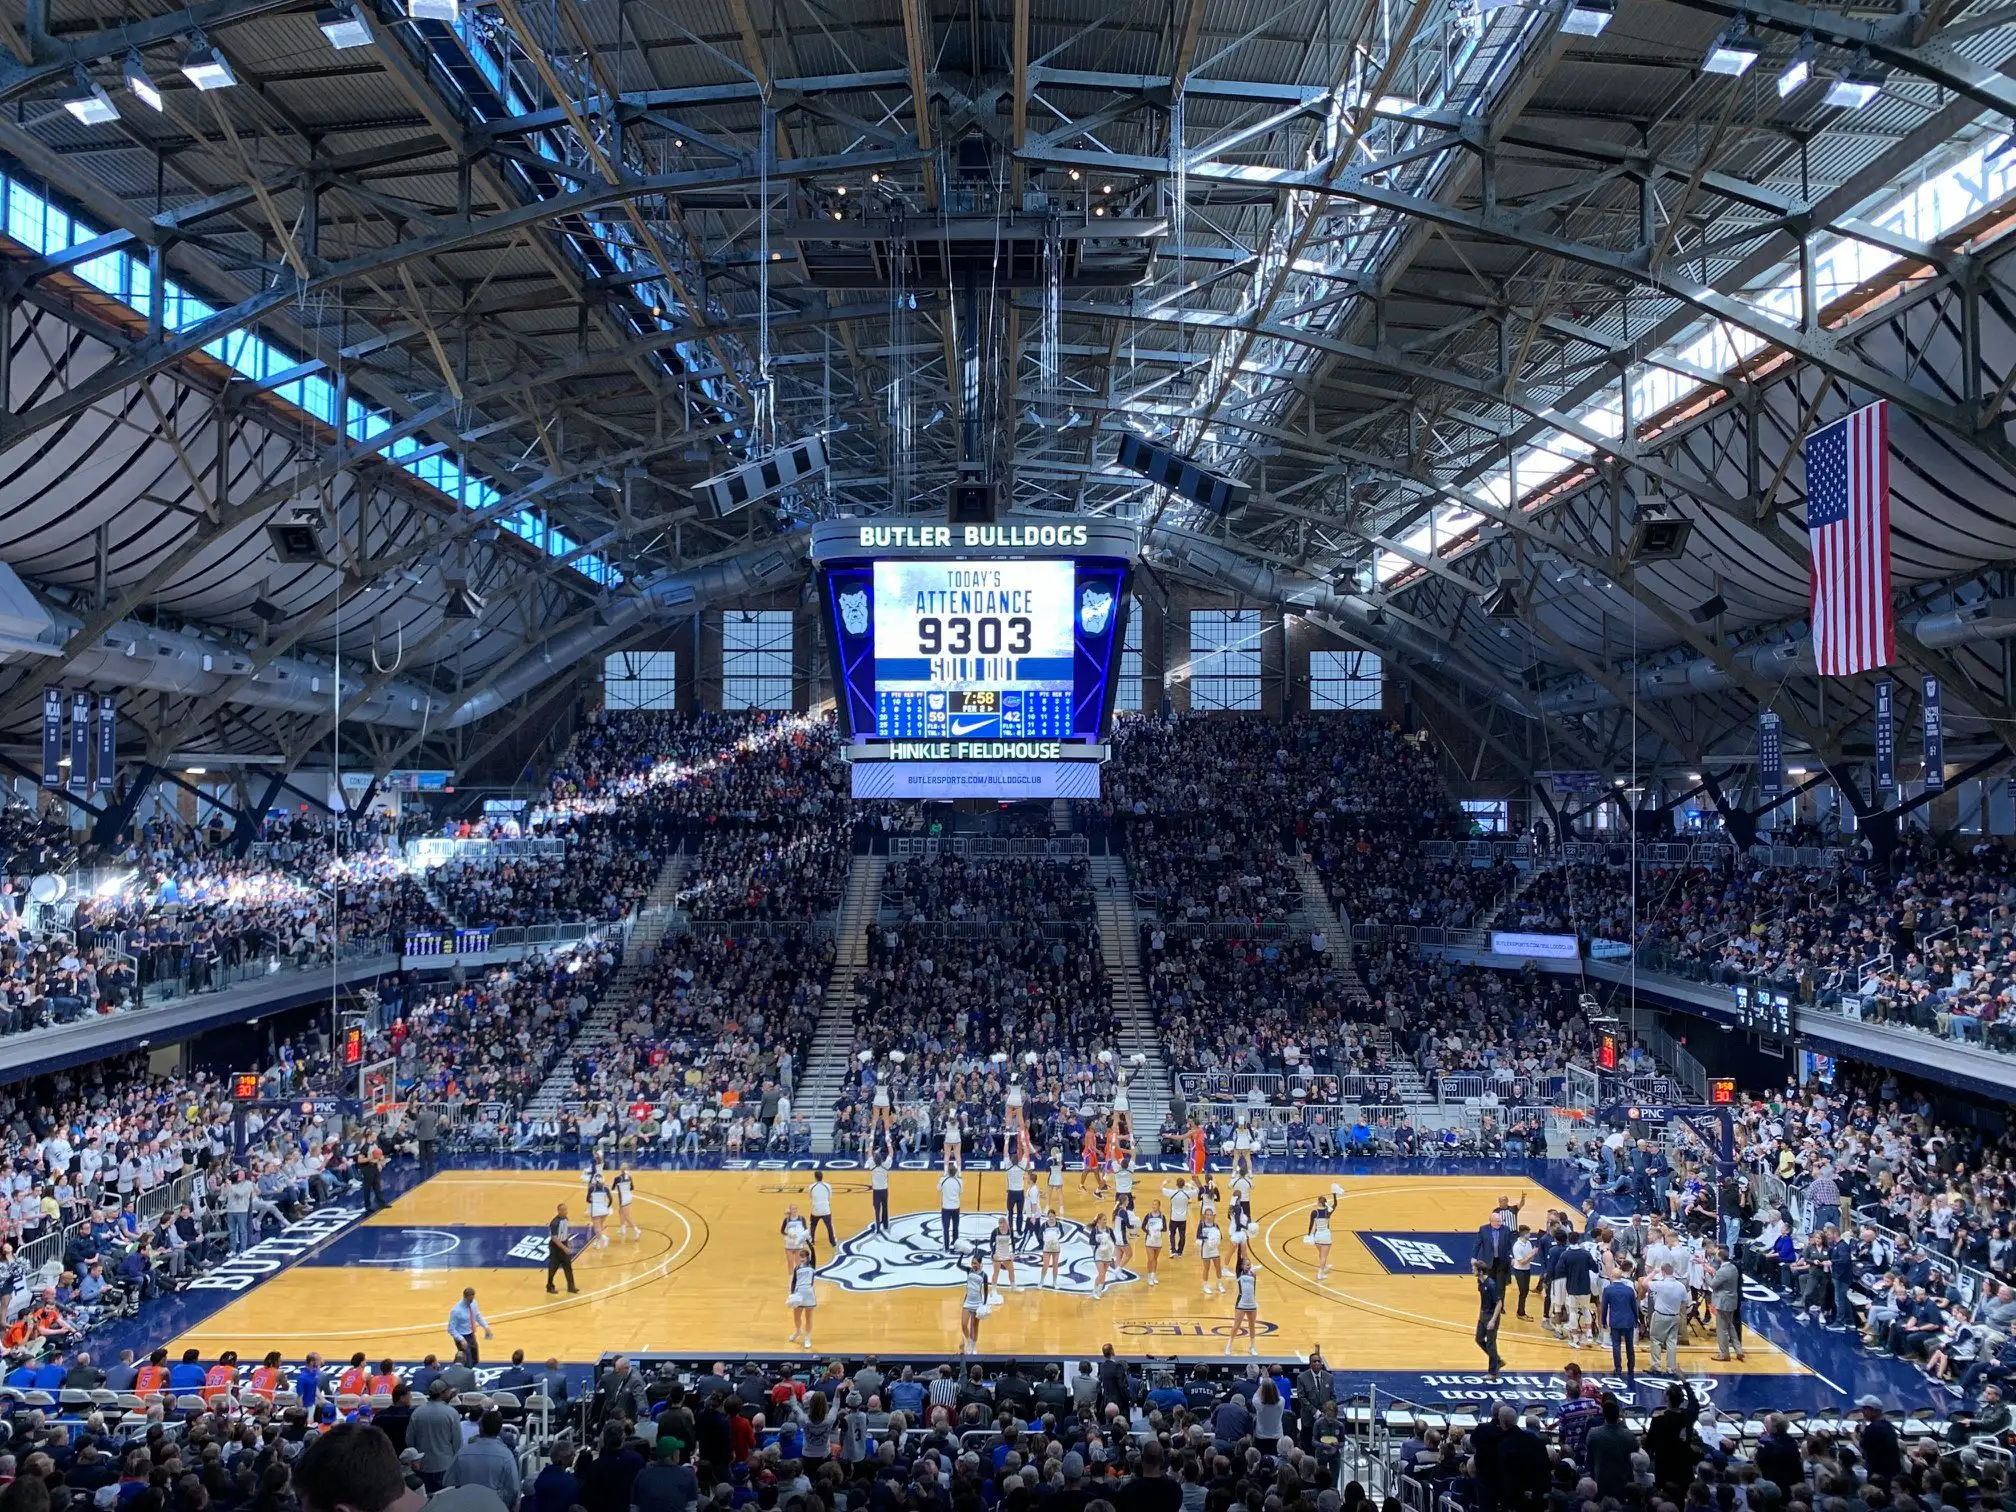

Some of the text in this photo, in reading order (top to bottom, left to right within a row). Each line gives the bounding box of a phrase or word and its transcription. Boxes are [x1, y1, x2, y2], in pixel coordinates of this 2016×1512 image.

[860, 526, 1087, 547] BUTLER BULLDOGS
[947, 571, 1001, 587] TODAY'S
[916, 590, 1033, 614] ATTENDANCE
[918, 617, 1032, 655] 9303
[930, 658, 1020, 681] SOLD OUT
[962, 692, 994, 705] 7:58
[929, 712, 945, 722] 59
[1003, 711, 1020, 722] 42
[889, 742, 1060, 760] HINKLE FIELDHOUSE
[908, 776, 1042, 784] BUTLERSPORTS.COM/BULLDOGCLUB
[236, 1085, 253, 1097] 30
[1185, 1080, 1195, 1089] 119
[1444, 1083, 1457, 1091] 120
[1654, 1085, 1667, 1094] 120
[1715, 1090, 1730, 1102] 30
[314, 1102, 336, 1112] PNC
[1641, 1108, 1665, 1118] PNC
[186, 1207, 367, 1291] BUTLER
[507, 1235, 544, 1258] BIG
[142, 1375, 150, 1388] 5
[207, 1375, 224, 1387] 33
[344, 1375, 355, 1388] 2
[1421, 1375, 1566, 1388] Vincent
[376, 1383, 389, 1395] 10
[1190, 1387, 1215, 1396] BUTLER
[1438, 1390, 1635, 1404] Aension
[854, 1428, 862, 1442] 3
